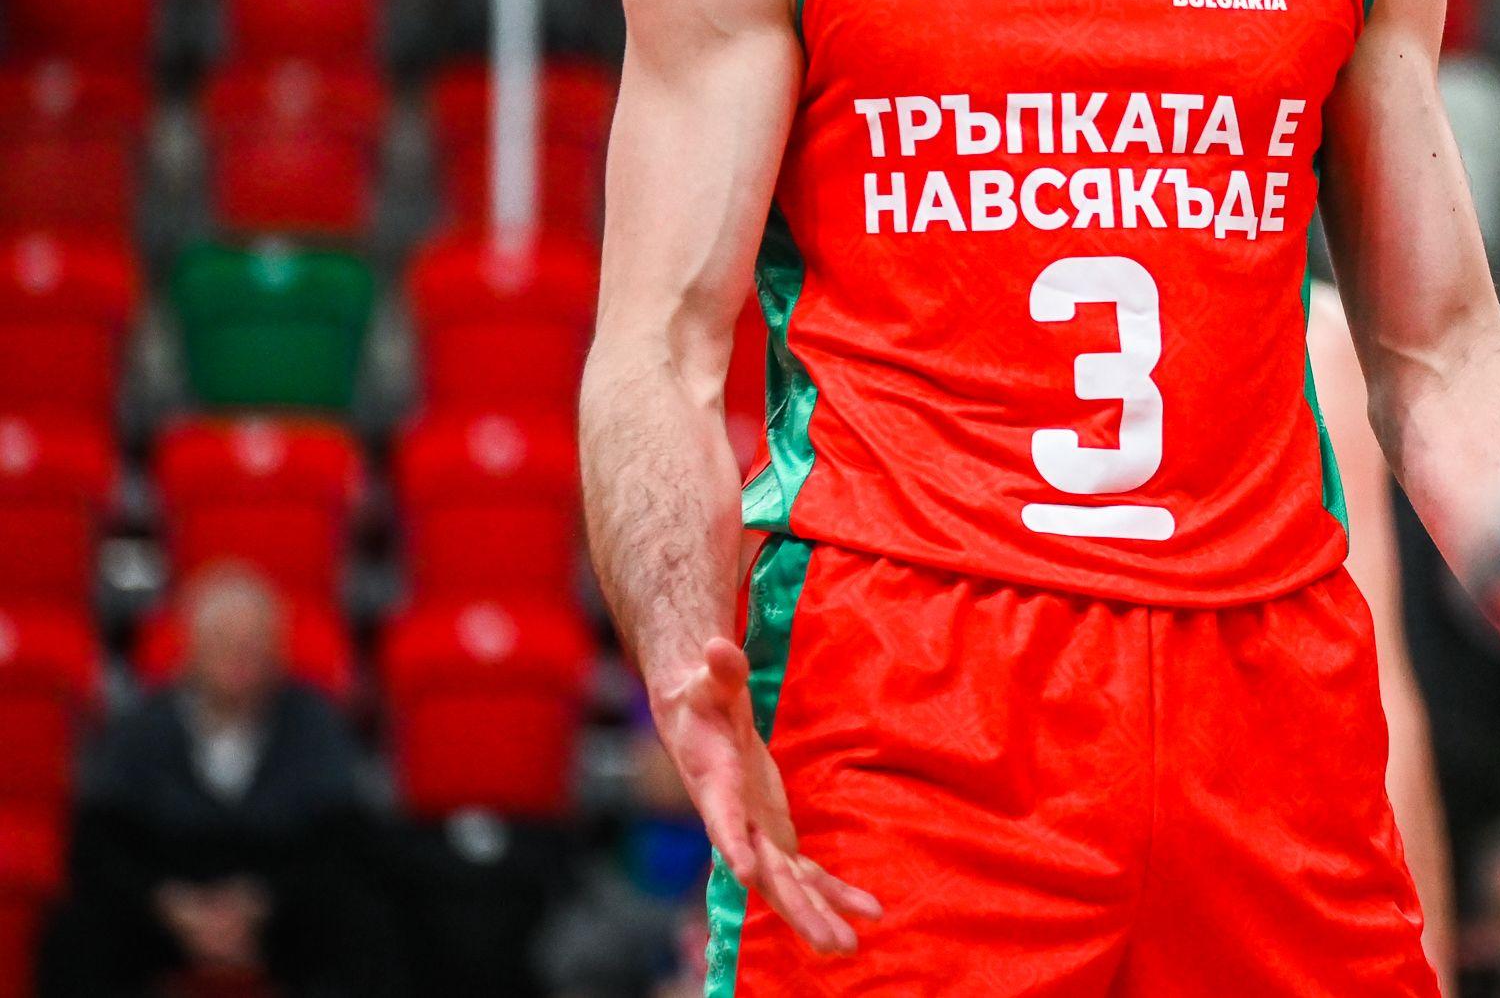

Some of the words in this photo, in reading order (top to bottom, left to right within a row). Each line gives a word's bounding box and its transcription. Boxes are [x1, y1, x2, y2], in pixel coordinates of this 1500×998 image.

[854, 92, 1244, 158] ТРЪПКАТА
[1267, 98, 1306, 157] Е
[863, 167, 1290, 241] НАВСЯКЪДЕ
[1029, 255, 1164, 495] 3
